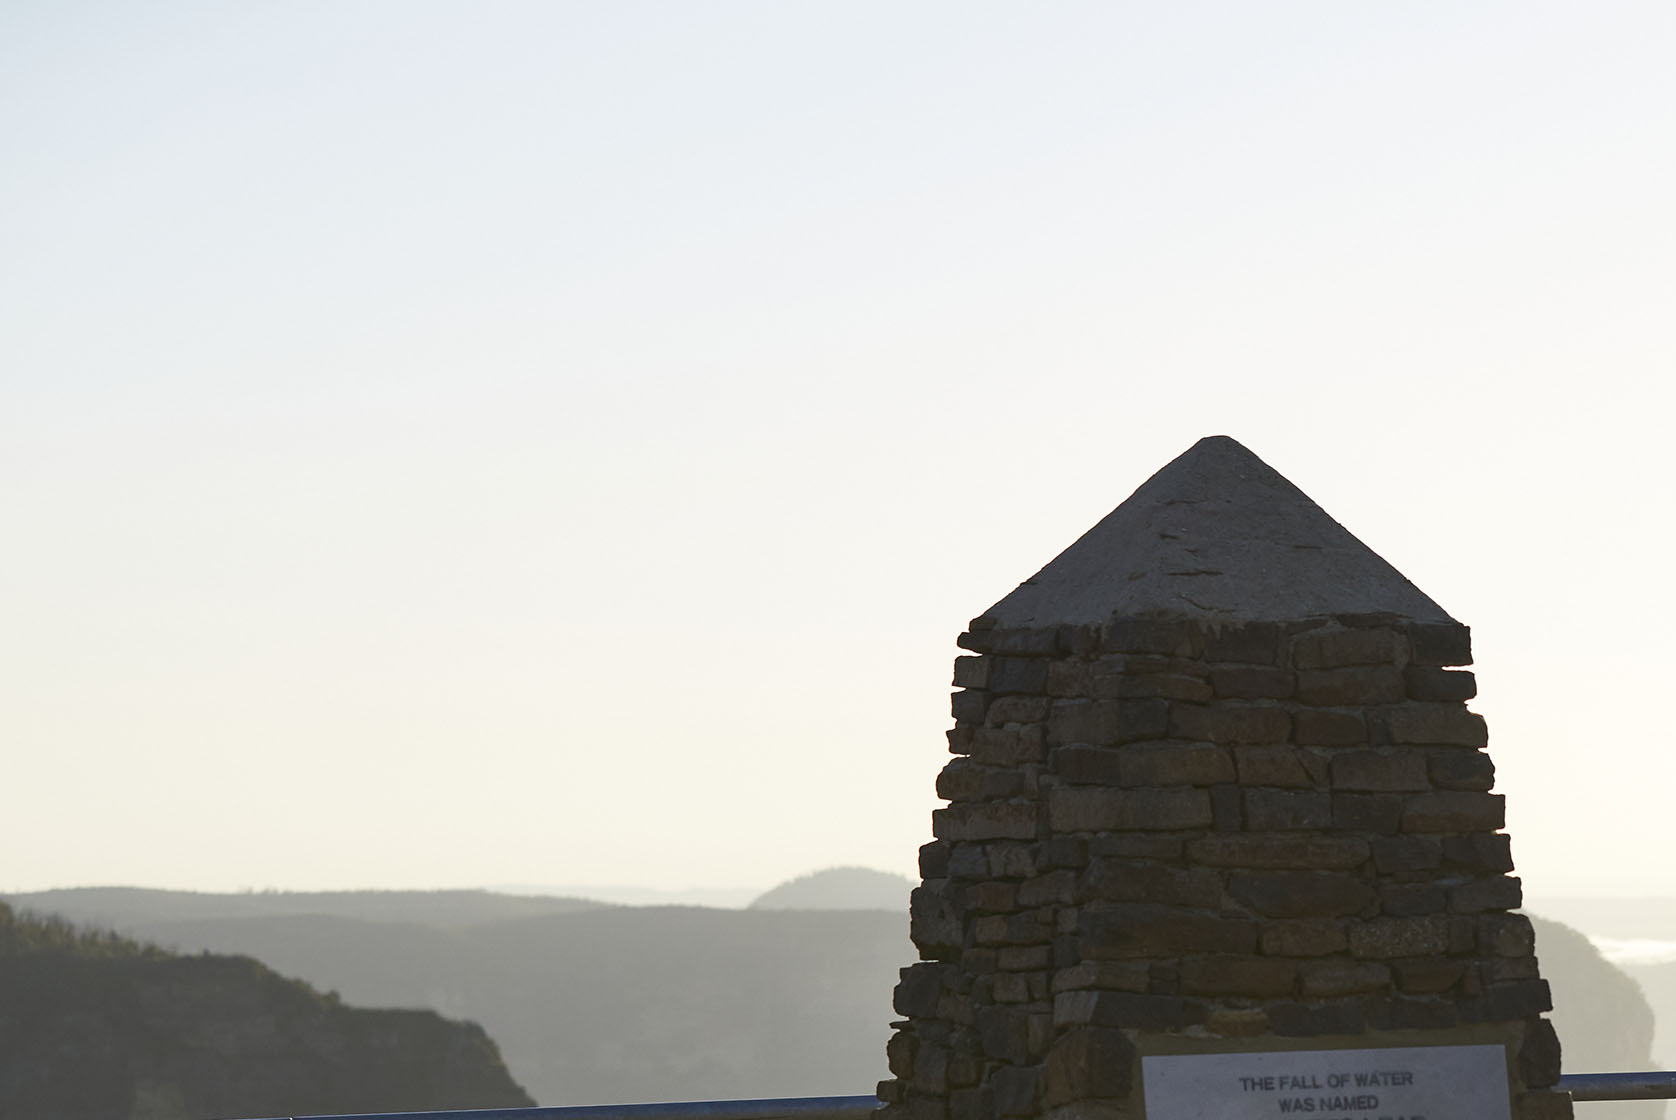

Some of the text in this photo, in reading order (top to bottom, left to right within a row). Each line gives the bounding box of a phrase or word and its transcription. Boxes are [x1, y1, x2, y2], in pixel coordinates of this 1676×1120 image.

[1239, 1072, 1414, 1092] THE FALL OF WATER
[1279, 1096, 1379, 1113] WAS NAMED
